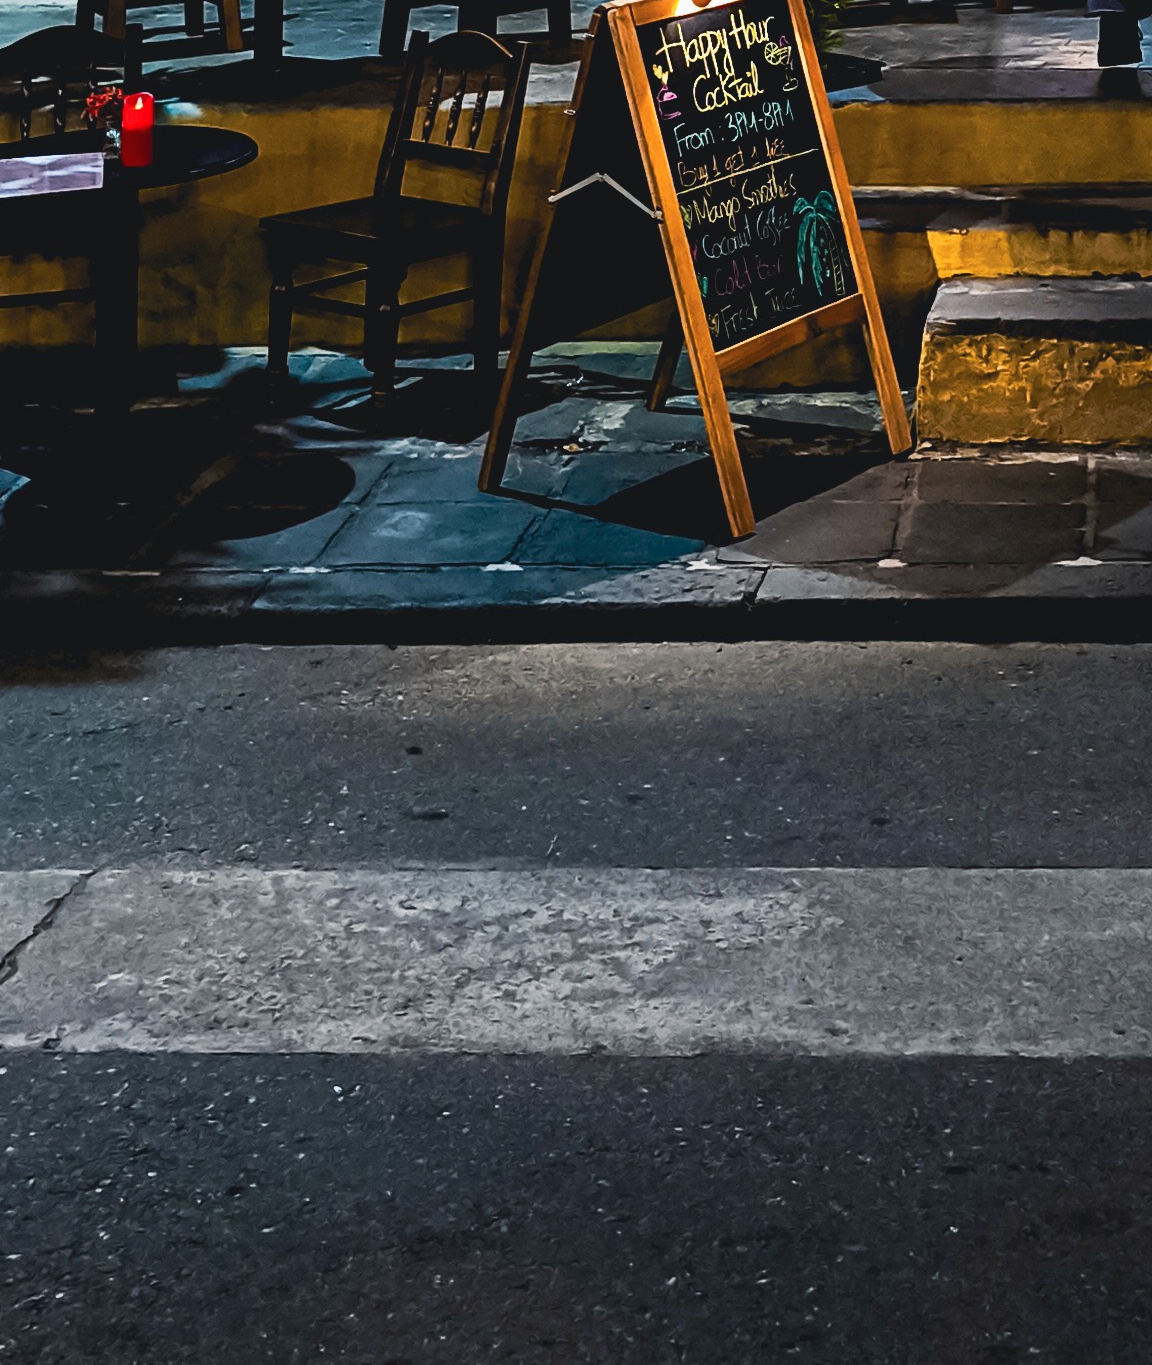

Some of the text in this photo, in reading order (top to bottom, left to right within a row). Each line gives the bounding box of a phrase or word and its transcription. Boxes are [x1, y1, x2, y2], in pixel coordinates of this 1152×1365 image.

[655, 8, 775, 80] Happy Hour
[692, 195, 741, 232] Mango
